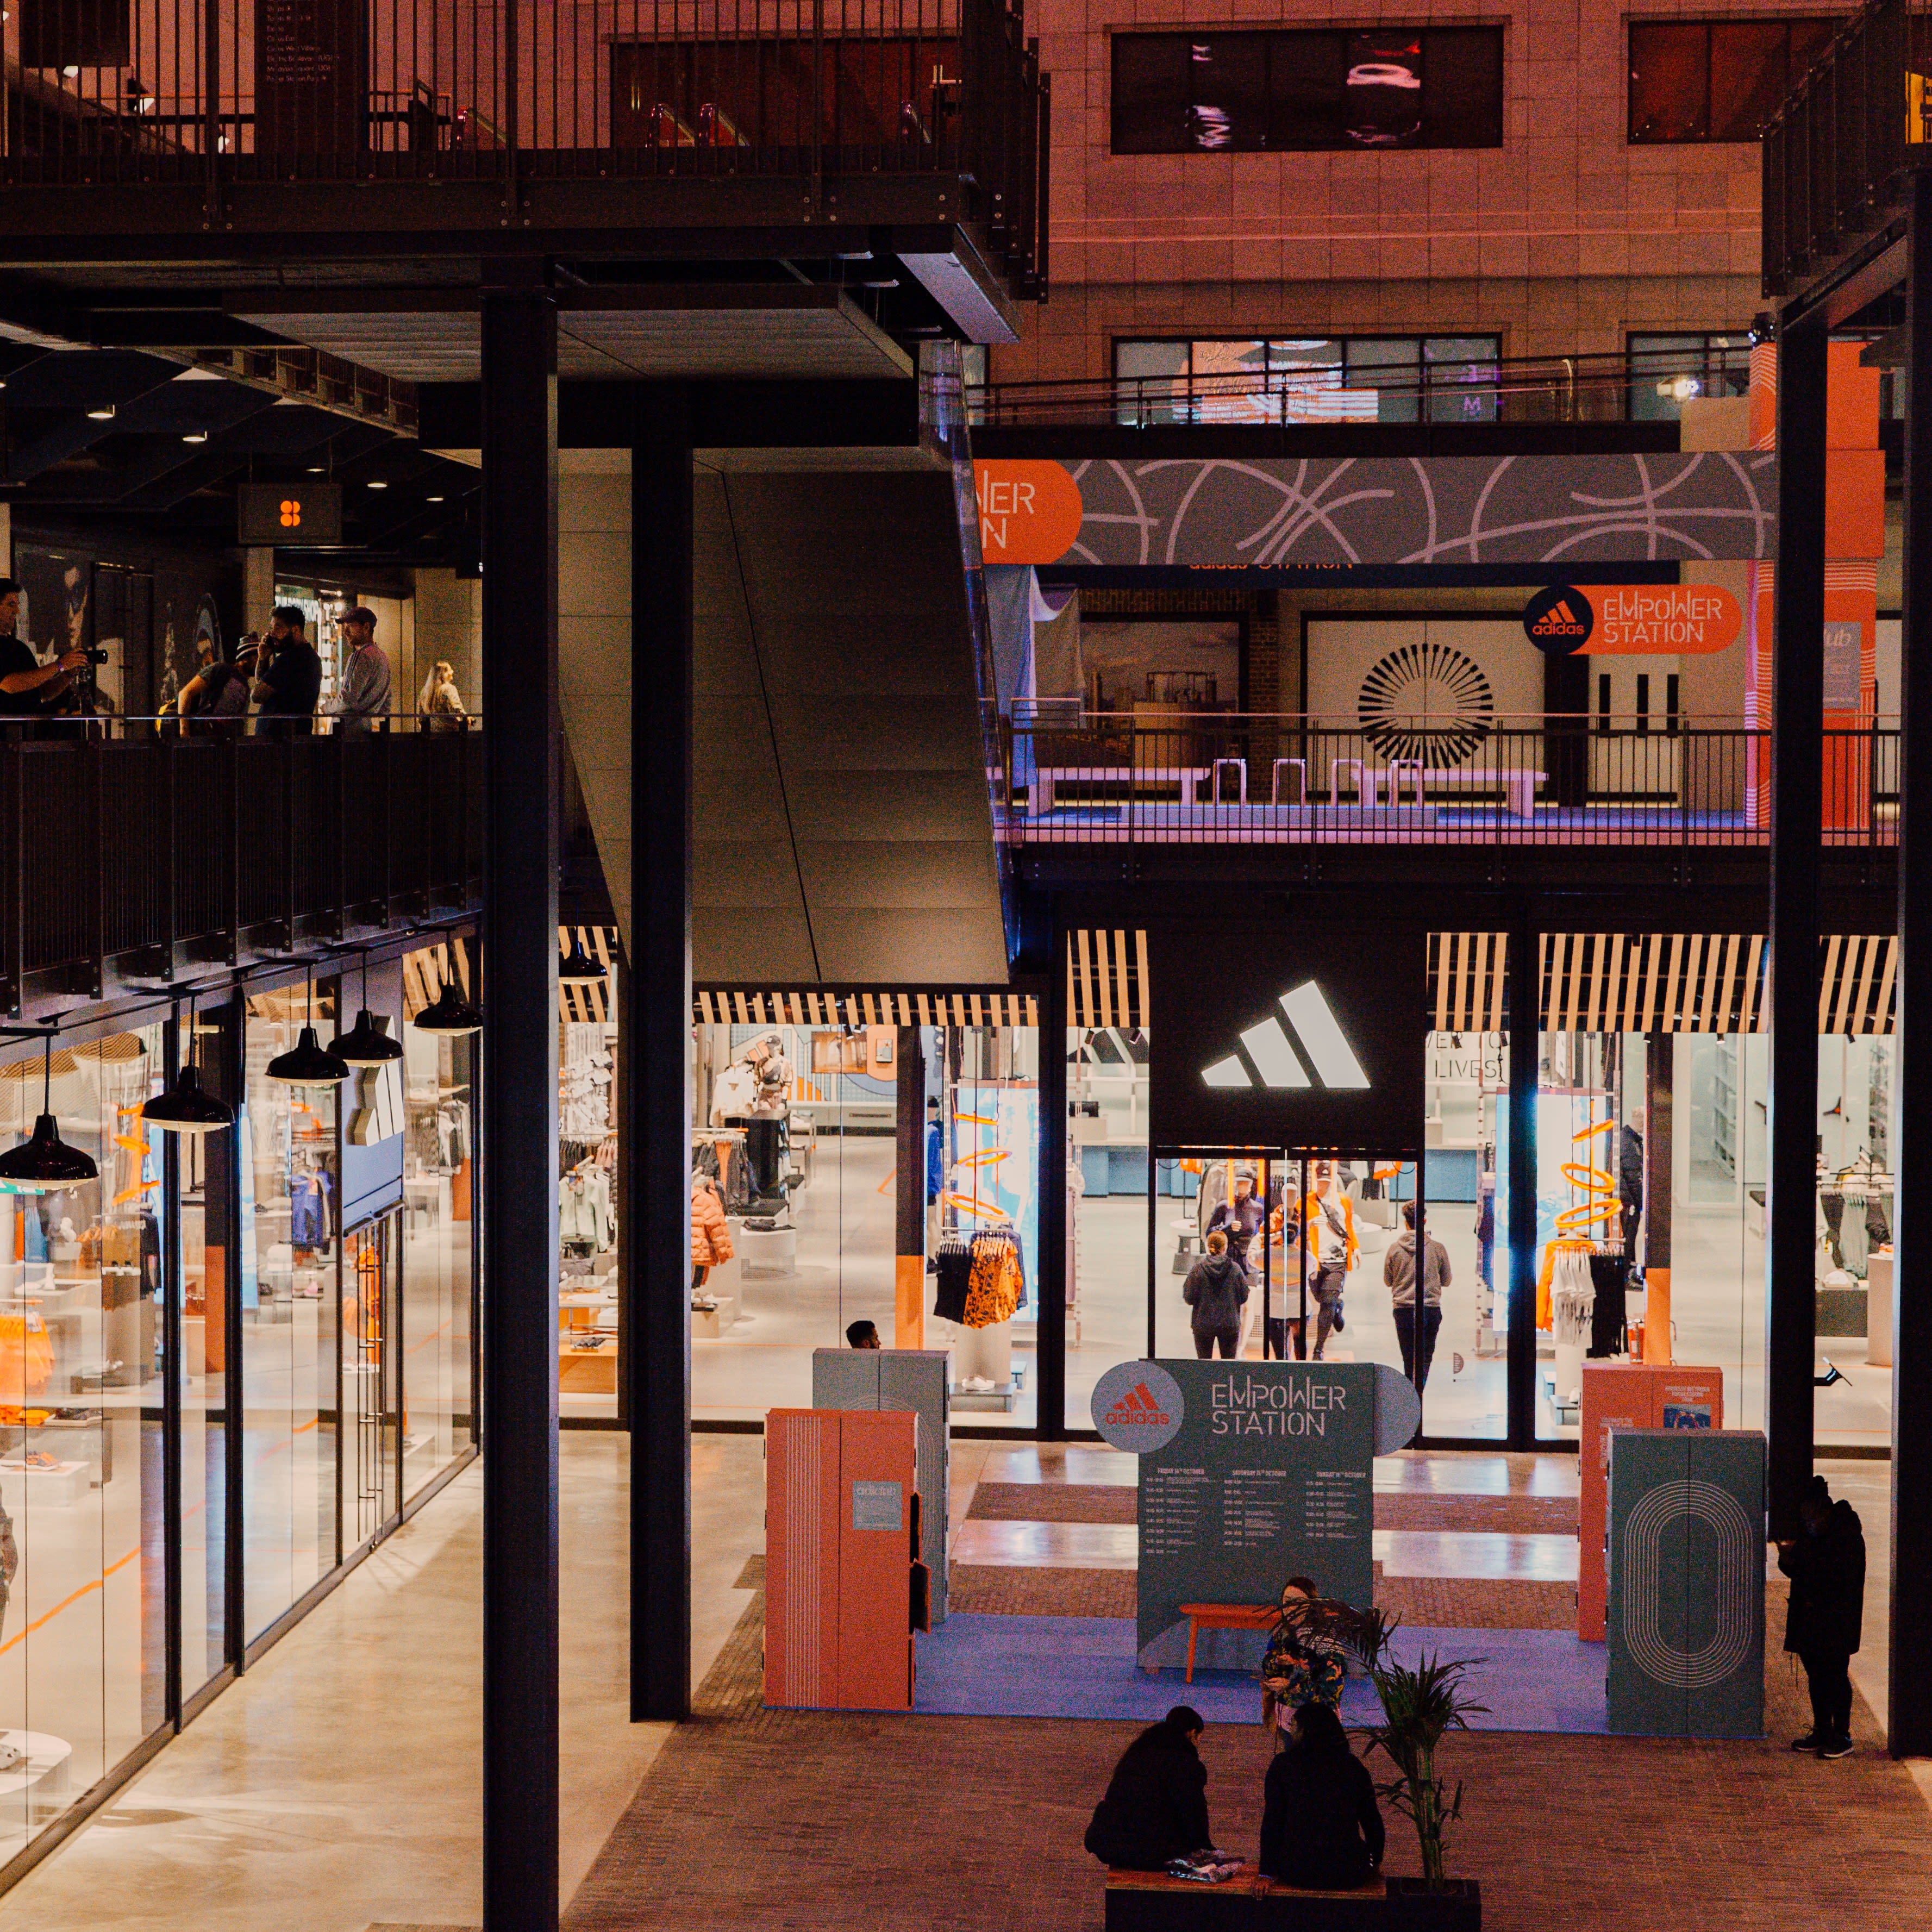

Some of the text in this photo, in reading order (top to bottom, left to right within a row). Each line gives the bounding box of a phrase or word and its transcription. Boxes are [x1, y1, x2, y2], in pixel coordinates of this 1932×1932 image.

[1604, 591, 1722, 620] EMPOWER
[1532, 623, 1585, 635] adidas
[1603, 621, 1704, 643] STATION
[1212, 1375, 1346, 1410] EMPOWER
[1105, 1410, 1170, 1425] adidas
[1212, 1411, 1325, 1435] STATION
